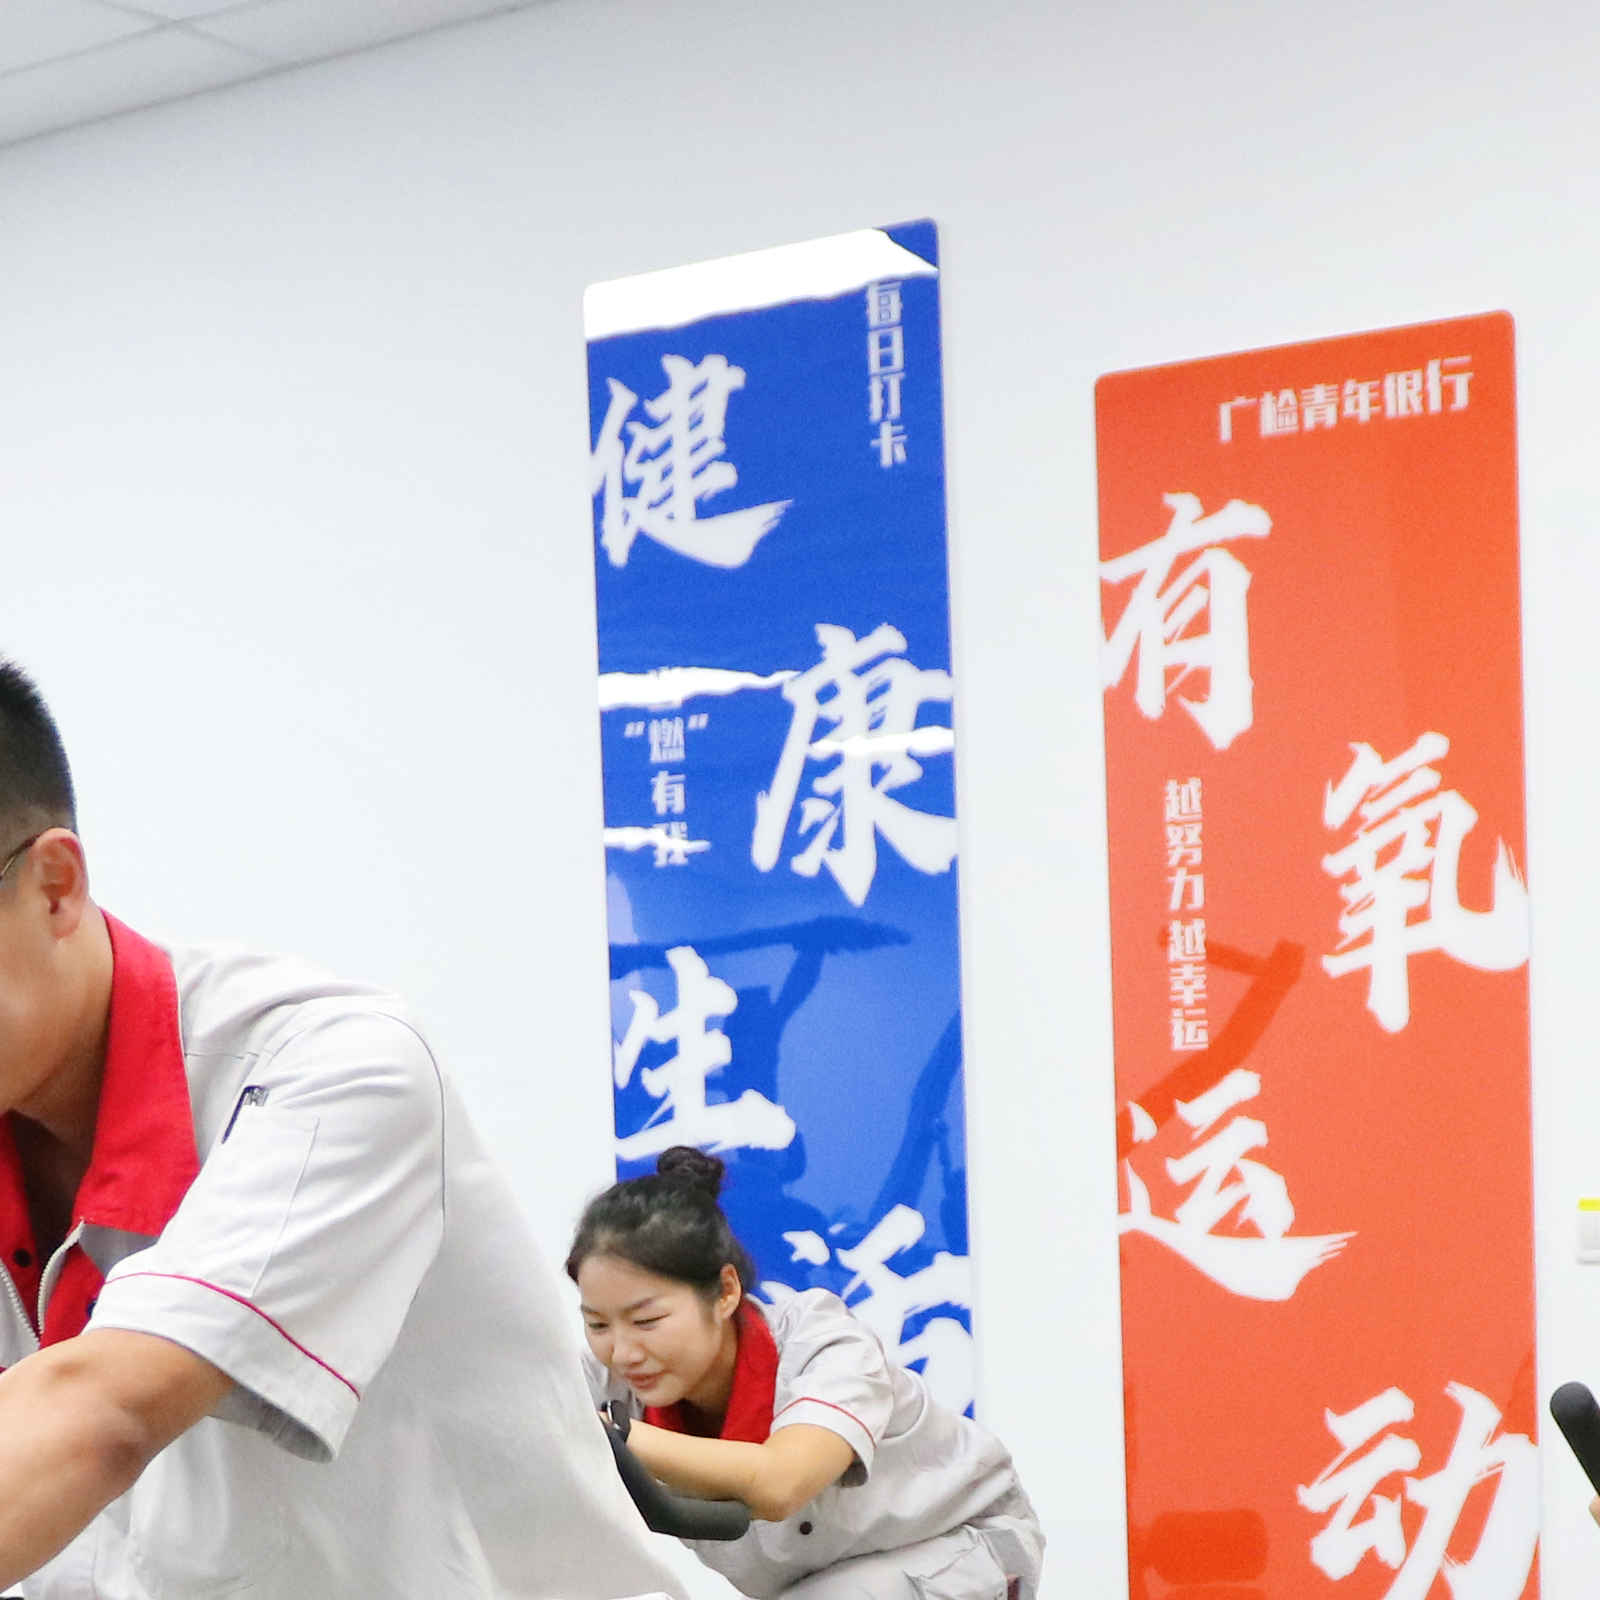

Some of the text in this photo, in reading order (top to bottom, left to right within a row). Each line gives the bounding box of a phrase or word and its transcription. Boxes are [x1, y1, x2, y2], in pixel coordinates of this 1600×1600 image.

[865, 281, 908, 468] 每日打卡
[1164, 777, 1209, 1051] 越努力 越幸运
